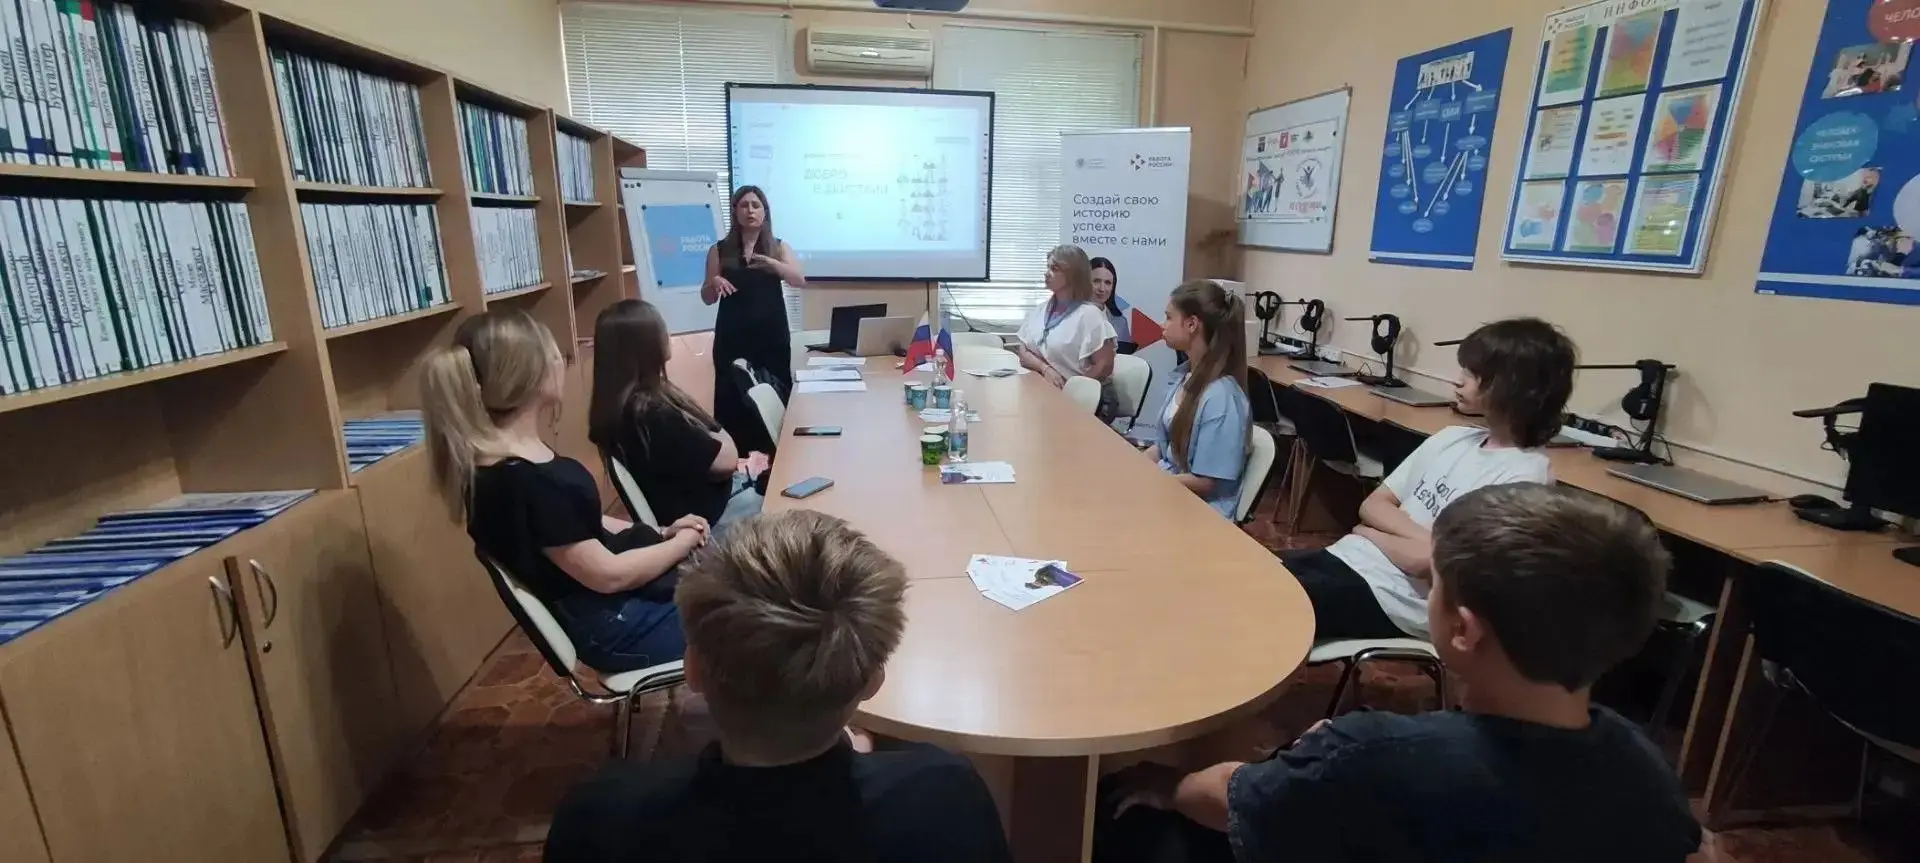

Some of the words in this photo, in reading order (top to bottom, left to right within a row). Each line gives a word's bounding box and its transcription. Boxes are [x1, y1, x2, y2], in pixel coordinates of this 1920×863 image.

[40, 42, 62, 110] Бухгалтер
[1073, 193, 1120, 206] Создай
[1124, 195, 1159, 206] свою
[1073, 209, 1131, 220] историю
[1072, 222, 1116, 233] успеха
[1072, 235, 1118, 245] вместе
[1121, 236, 1129, 245] с
[1132, 236, 1167, 247] нами
[15, 254, 44, 325] Картограф
[54, 241, 83, 329] Коммивояжер
[191, 246, 211, 305] Массажист
